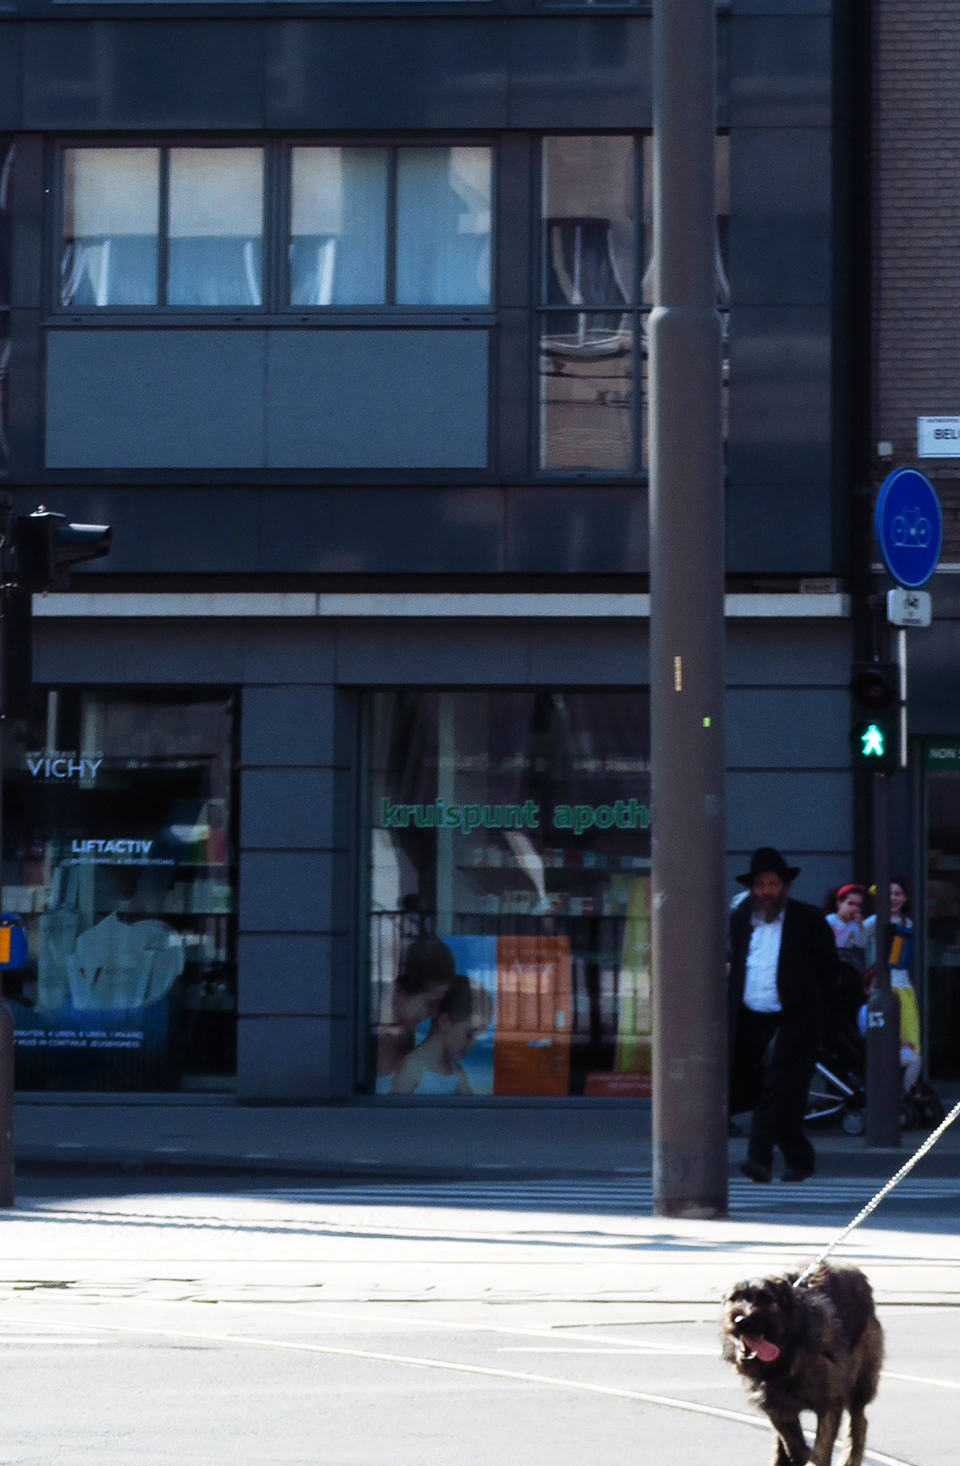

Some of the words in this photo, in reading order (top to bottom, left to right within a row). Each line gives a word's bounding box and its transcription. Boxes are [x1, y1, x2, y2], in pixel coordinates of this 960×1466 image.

[928, 748, 955, 759] NON
[26, 758, 103, 778] VICHY
[380, 797, 540, 835] kruispunt
[553, 798, 650, 835] apoth
[71, 839, 153, 853] LIFTACTIV
